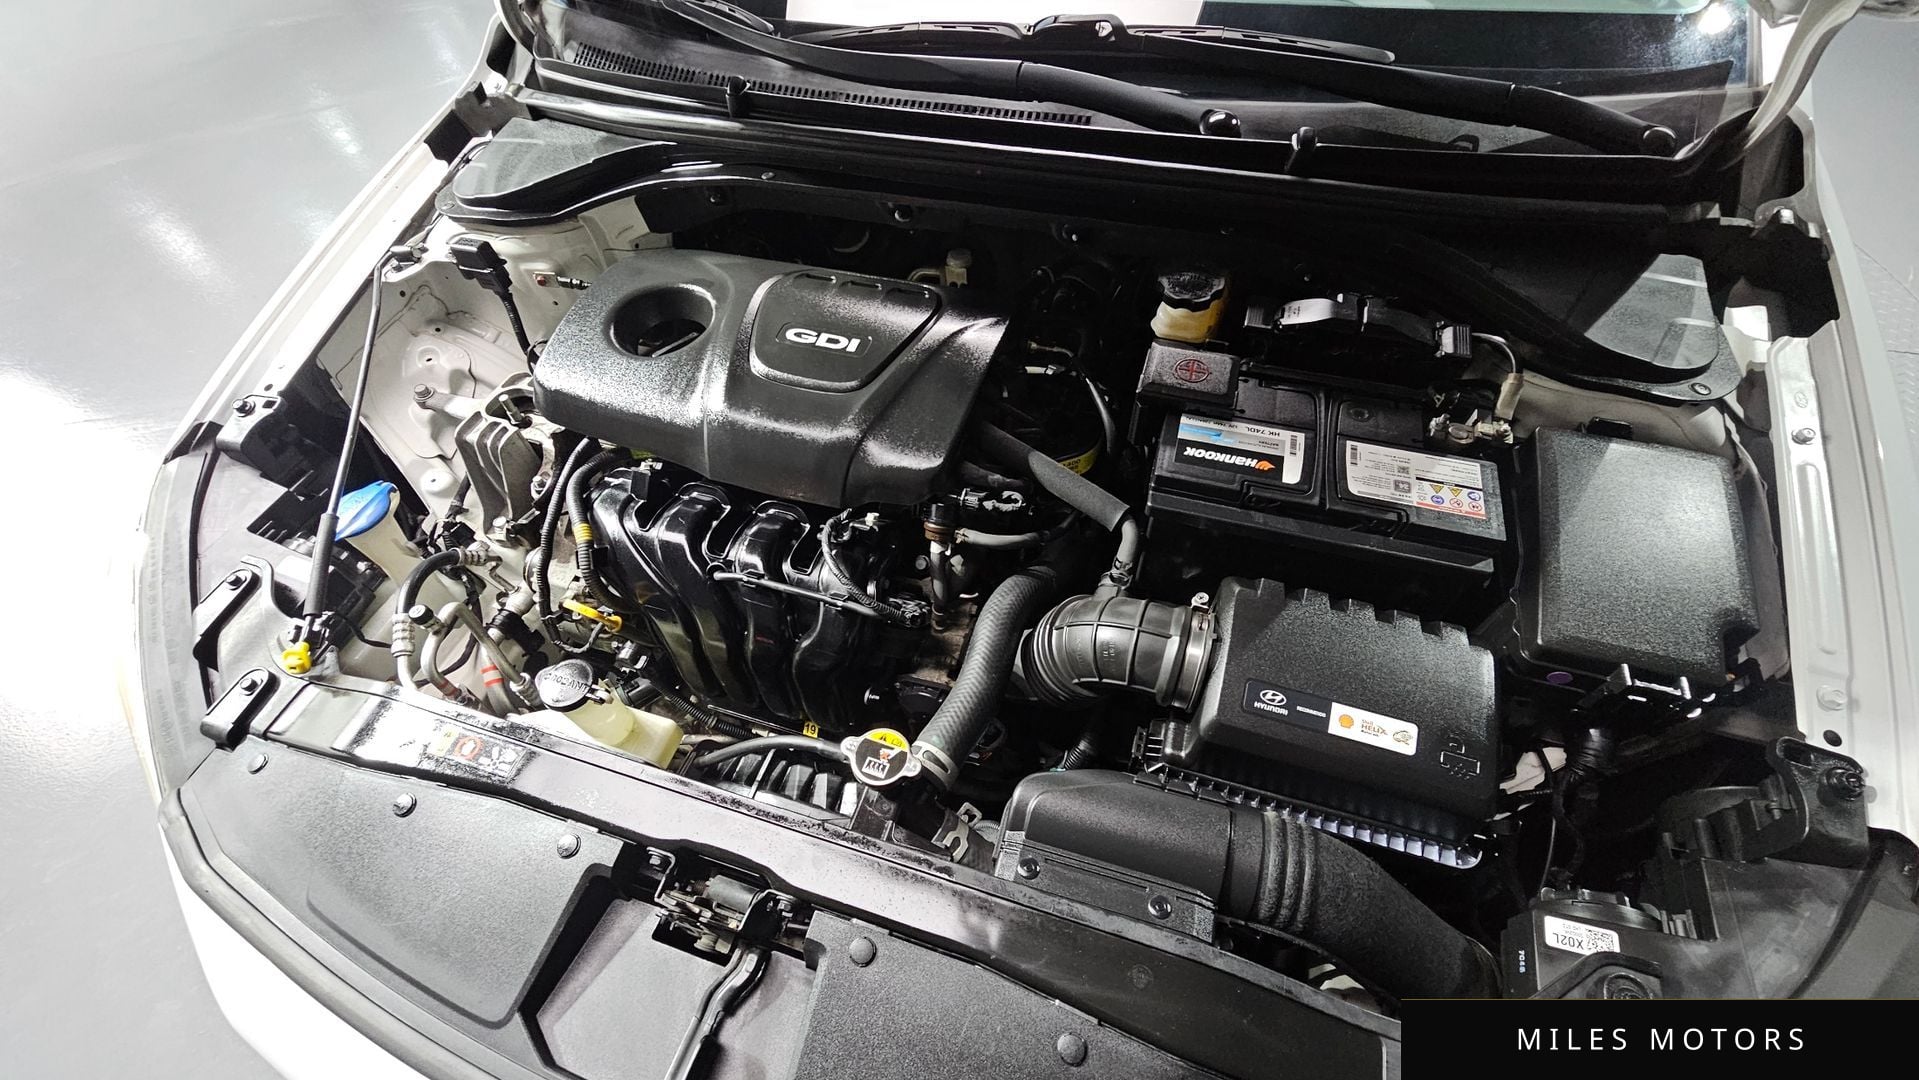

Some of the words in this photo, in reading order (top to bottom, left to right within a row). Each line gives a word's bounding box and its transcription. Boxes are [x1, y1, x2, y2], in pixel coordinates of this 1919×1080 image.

[785, 328, 861, 352] GDI
[1254, 701, 1289, 716] HYUNDAI
[805, 723, 816, 736] 19
[1361, 723, 1388, 736] HELIX
[1553, 932, 1585, 950] X02L
